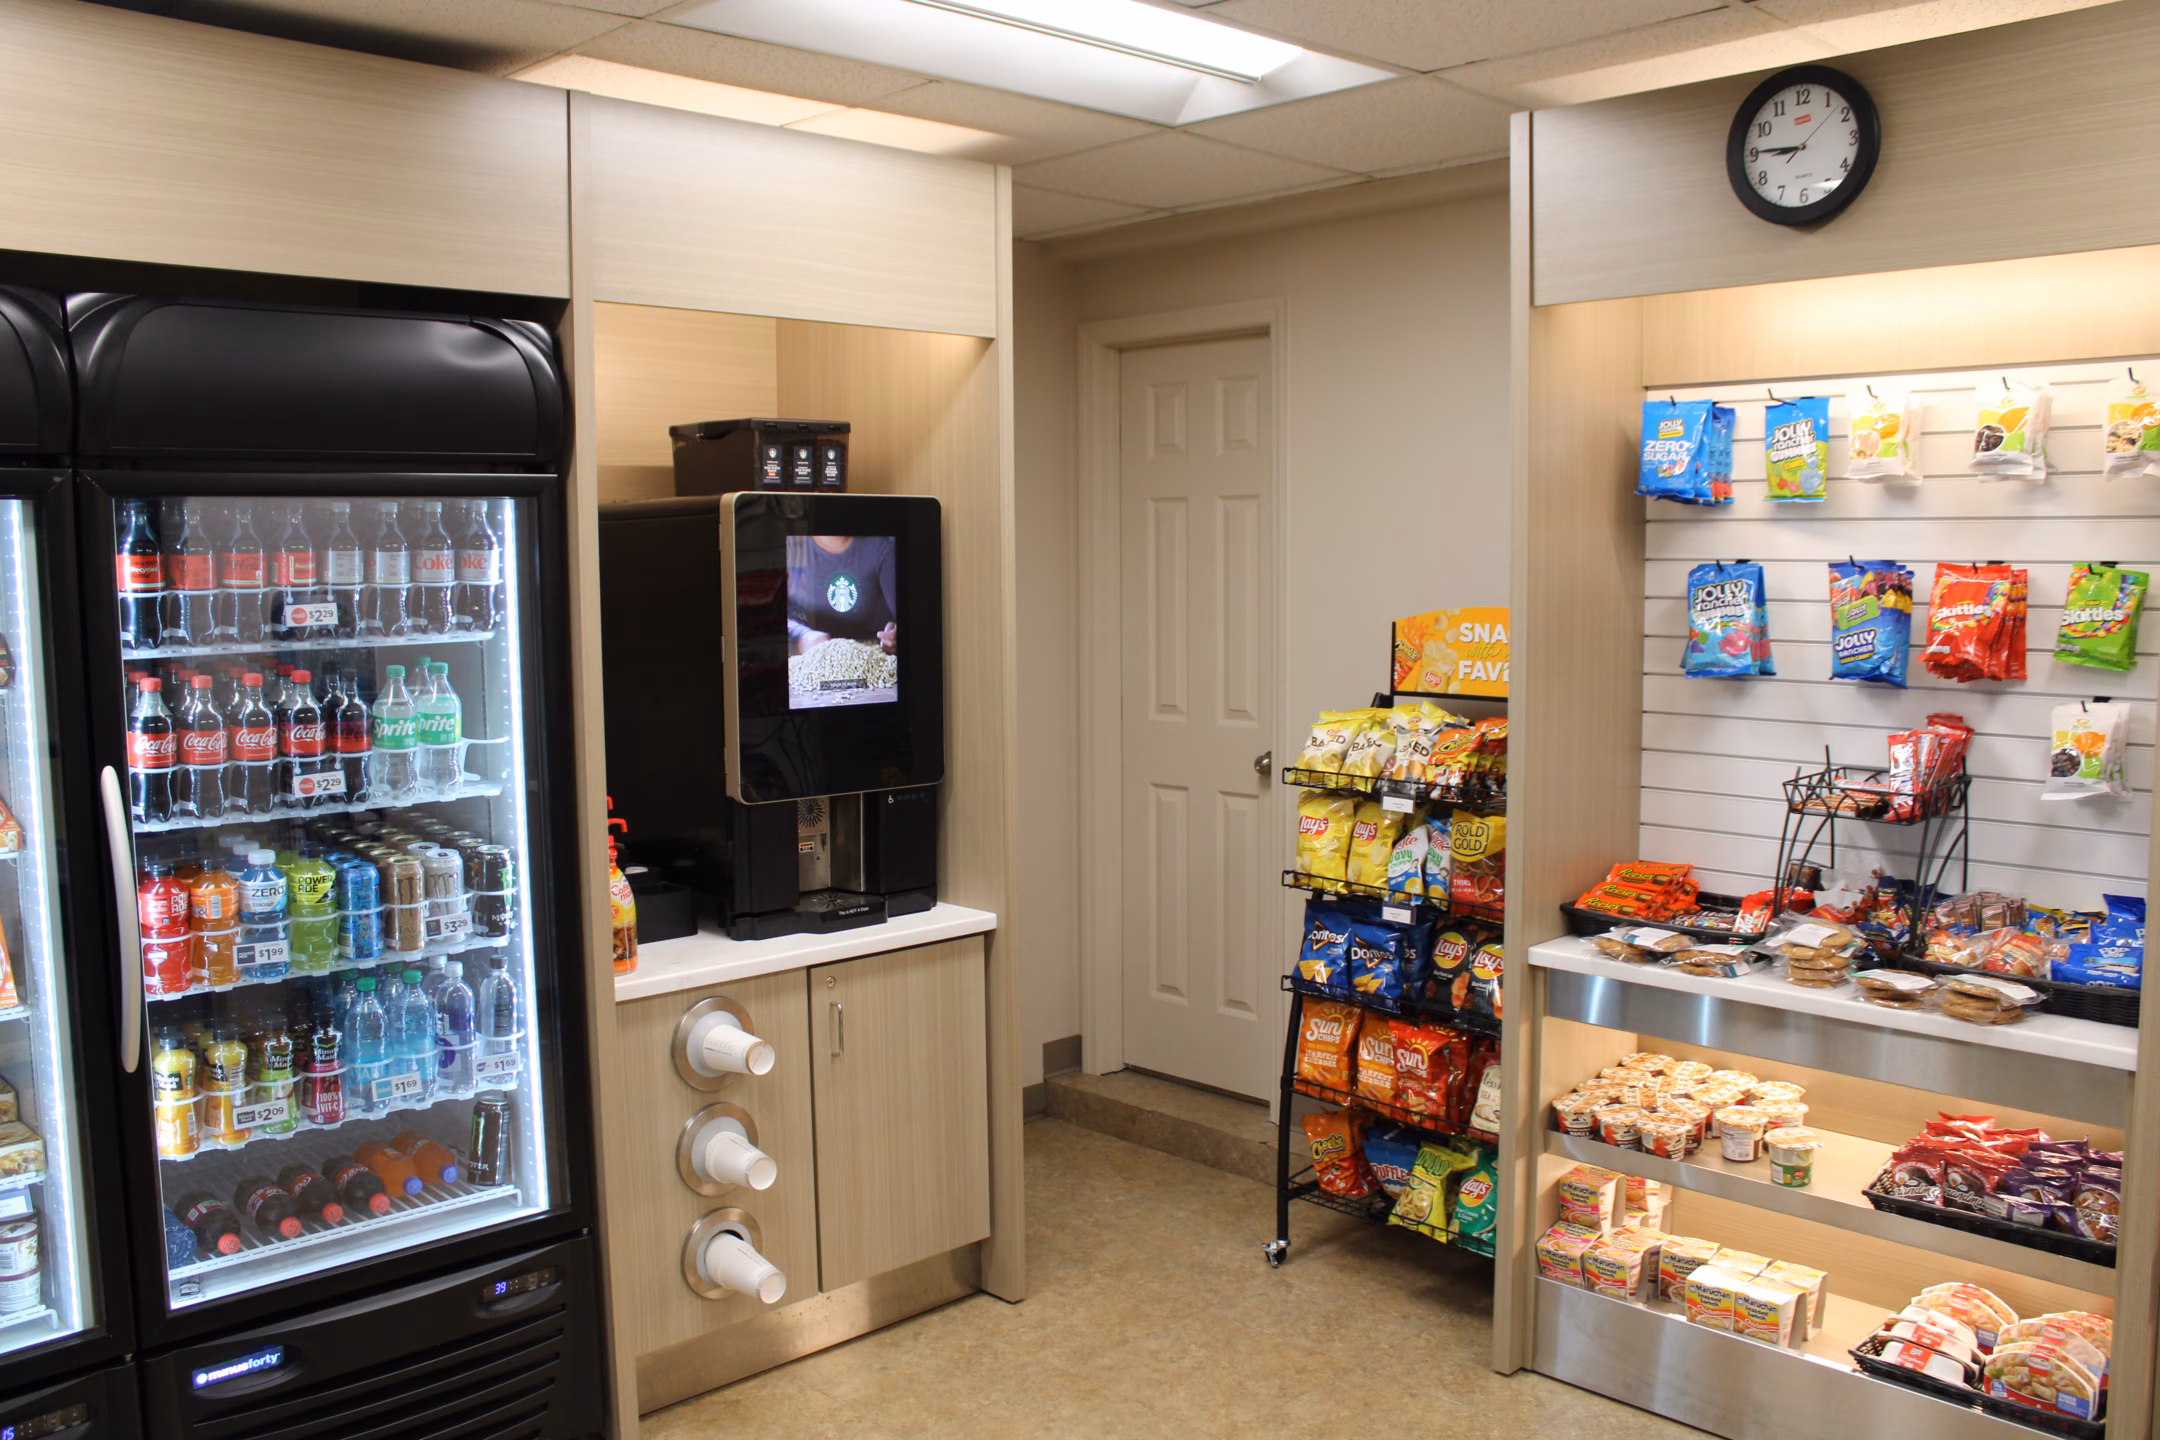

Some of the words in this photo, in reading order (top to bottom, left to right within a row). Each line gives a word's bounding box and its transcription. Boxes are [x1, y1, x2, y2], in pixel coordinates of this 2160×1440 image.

[1795, 88, 1811, 106] 12
[1825, 91, 1832, 108] 1
[1773, 100, 1786, 117] 11
[1841, 106, 1850, 123] 2
[1757, 120, 1772, 138] 10
[1848, 130, 1859, 146] 3
[1750, 147, 1759, 163] 9
[1839, 157, 1850, 173] 4
[1758, 170, 1768, 186] 8
[1777, 185, 1786, 201] 7
[1800, 188, 1809, 204] 6
[1772, 419, 1812, 444] JOLLY
[1645, 440, 1688, 452] ZERO
[1644, 451, 1687, 461] SUGAR
[414, 552, 453, 571] Coke
[459, 552, 487, 570] oke
[1695, 580, 1745, 603] JOLLY
[1697, 593, 1748, 611] rancher
[2061, 607, 2124, 626] Skittles
[1460, 622, 1509, 644] SNA
[1835, 630, 1875, 650] JOLLY
[374, 718, 415, 738] Sprite
[418, 714, 454, 732] prite
[1300, 816, 1327, 835] Lay's
[1353, 821, 1377, 841] Lay's
[1456, 825, 1485, 838] ROLD
[1454, 838, 1482, 851] GOLD
[298, 874, 334, 885] POWER
[252, 888, 285, 898] ZERO
[1435, 939, 1465, 960] Lay's
[1306, 1018, 1341, 1041] Sun
[1317, 1034, 1341, 1044] CHIPS
[1305, 1050, 1338, 1060] HARVEST
[1362, 1036, 1395, 1061] Sun
[1396, 1049, 1428, 1072] Sun
[319, 1092, 340, 1101] 100%
[319, 1101, 339, 1112] VIT-C
[1312, 1135, 1344, 1160] Cheetos
[495, 1281, 507, 1295] 39
[207, 1352, 280, 1381] minusforty
